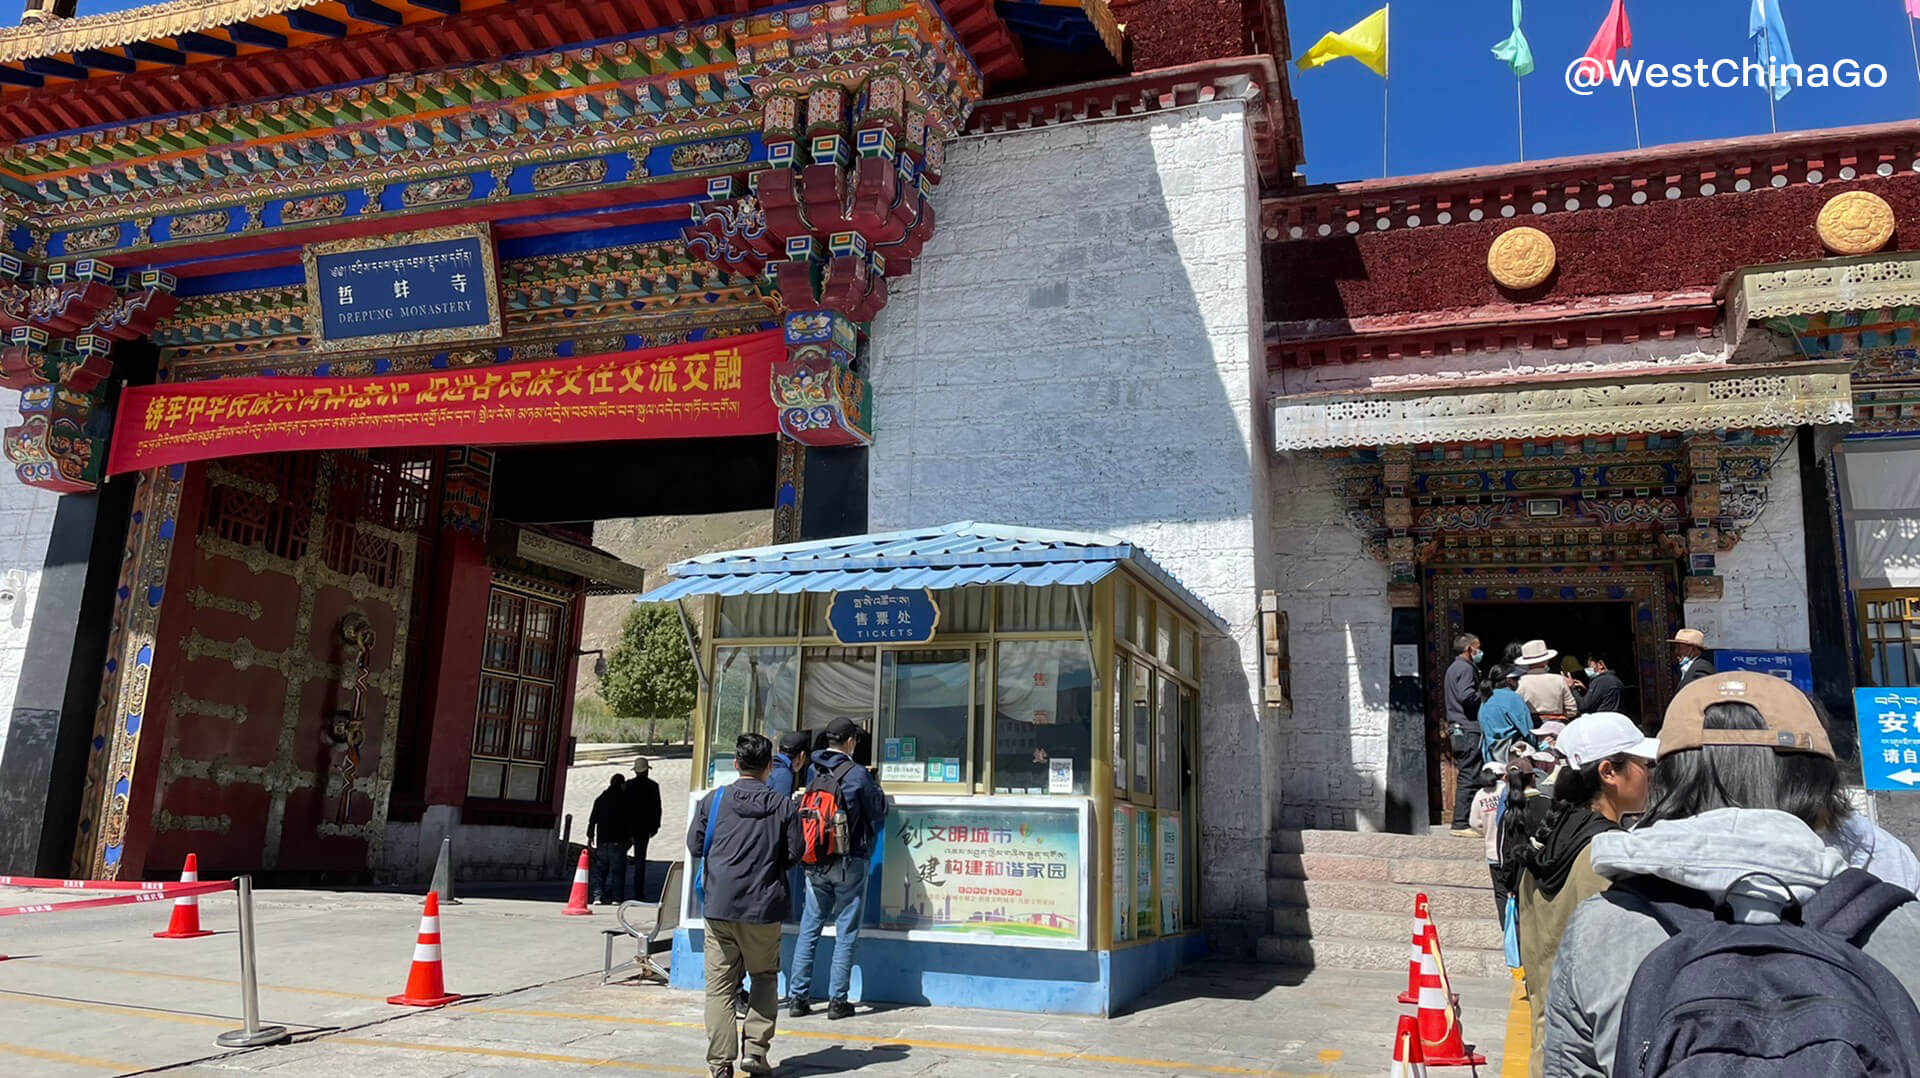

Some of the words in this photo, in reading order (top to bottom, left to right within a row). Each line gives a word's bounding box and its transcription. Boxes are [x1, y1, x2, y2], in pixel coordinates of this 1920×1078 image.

[338, 308, 393, 324] DREPUNG
[400, 300, 472, 318] MONASTERY
[855, 610, 912, 626] 售票处
[857, 629, 913, 638] TICKETS
[927, 826, 1013, 845] 文明城市
[944, 859, 1067, 879] 构建和谐家园
